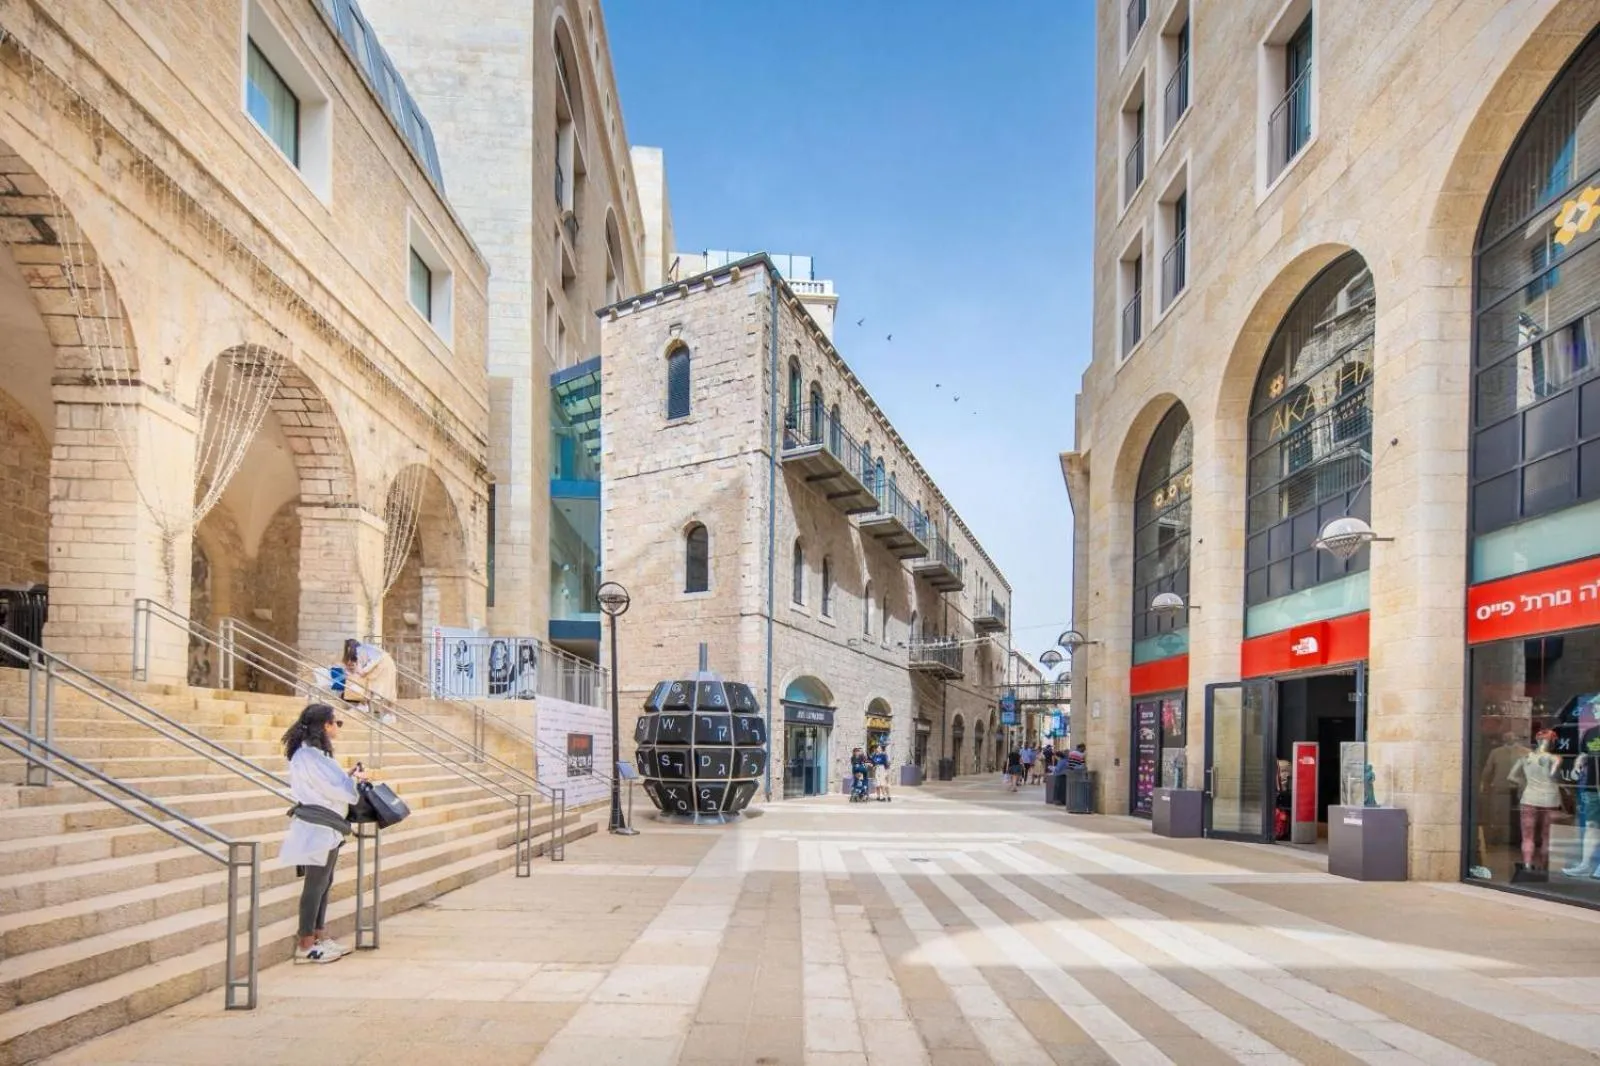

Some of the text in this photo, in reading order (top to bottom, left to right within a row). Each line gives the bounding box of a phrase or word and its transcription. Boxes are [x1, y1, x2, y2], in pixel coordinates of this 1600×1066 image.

[1476, 600, 1516, 621] פייס
[677, 695, 686, 704] 2
[714, 695, 723, 705] 3
[662, 718, 675, 730] W
[741, 719, 748, 730] R
[662, 754, 671, 766] S
[701, 755, 712, 767] D
[741, 754, 748, 766] F
[667, 789, 678, 799] X
[700, 789, 711, 799] C
